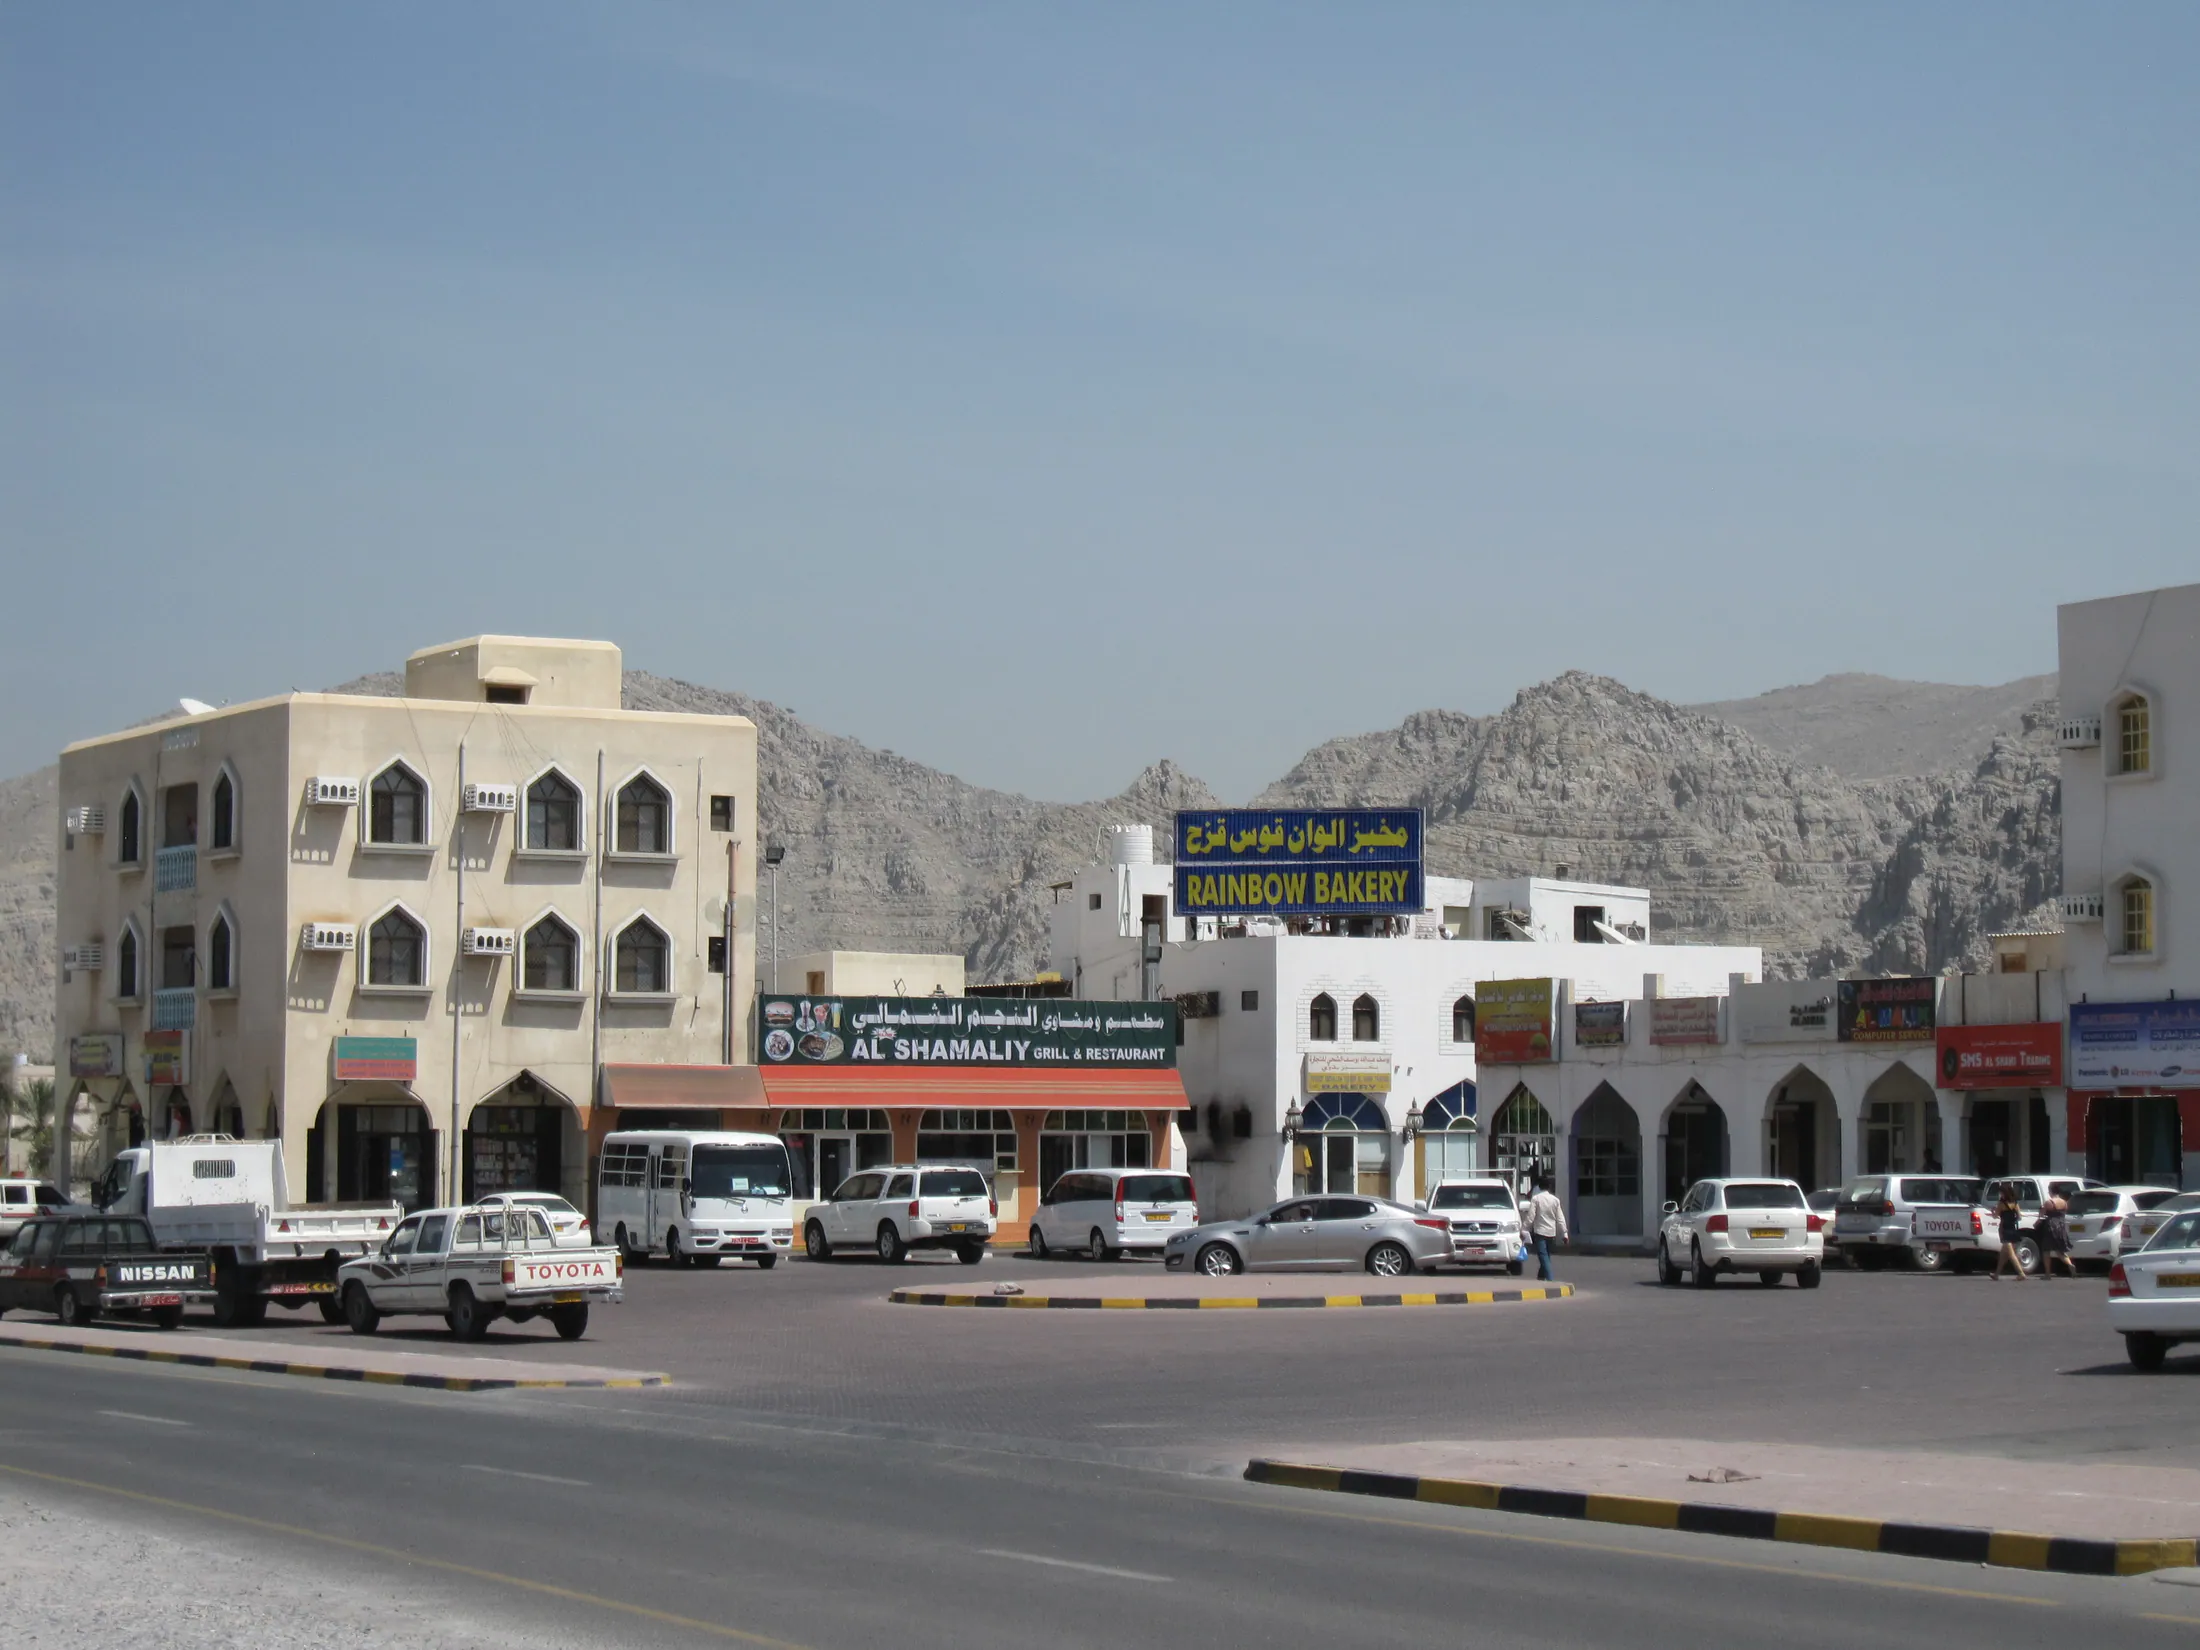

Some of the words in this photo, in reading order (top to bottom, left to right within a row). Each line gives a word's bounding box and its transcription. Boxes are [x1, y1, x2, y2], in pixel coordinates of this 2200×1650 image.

[1186, 818, 1227, 854] قزح
[1229, 818, 1284, 854] قوس
[1287, 818, 1345, 854] الوان
[1349, 818, 1409, 854] مخبز
[1187, 872, 1307, 906] RAINBOW
[1314, 870, 1409, 904] BAKERY
[852, 1002, 962, 1034] الشمالي
[968, 1005, 1037, 1033] النجم
[1042, 1012, 1101, 1035] ومشاوي
[1105, 1012, 1164, 1034] مطعم
[1853, 1031, 1896, 1040] COMPUTER
[1899, 1030, 1931, 1039] SERVICE
[851, 1039, 885, 1060] AL
[894, 1039, 1031, 1060] SHAMALIY
[1034, 1048, 1069, 1060] GRILL
[1073, 1048, 1082, 1060] &
[1086, 1047, 1165, 1060] RESTAURANT
[1960, 1052, 1982, 1068] SMS
[1924, 1220, 1962, 1231] TOYOTA
[120, 1265, 195, 1281] NISSAN
[526, 1263, 605, 1280] TOYOTA
